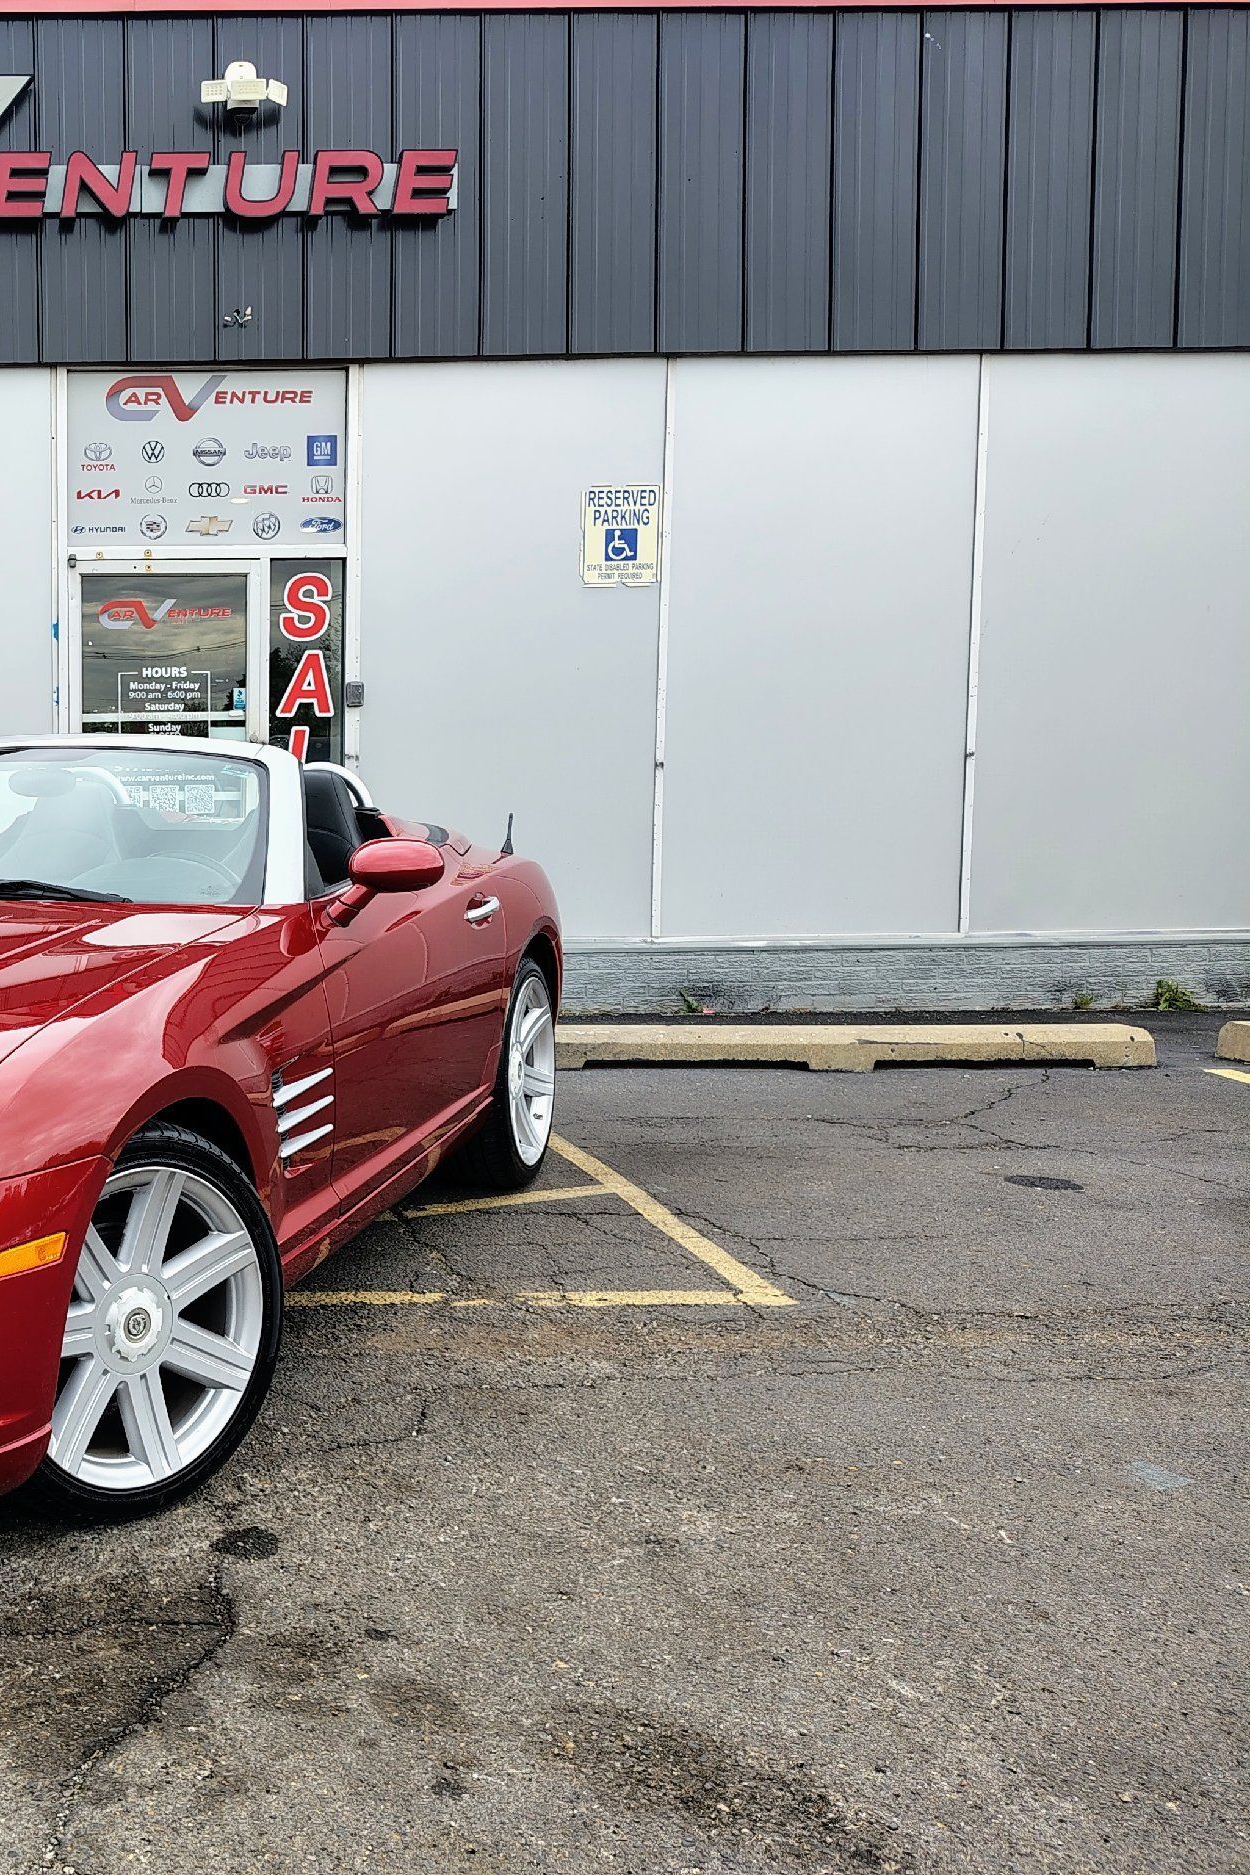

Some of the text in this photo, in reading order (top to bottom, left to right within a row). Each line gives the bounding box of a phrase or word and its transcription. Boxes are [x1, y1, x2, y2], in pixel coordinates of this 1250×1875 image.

[244, 443, 292, 461] Jeep
[313, 442, 331, 455] GM
[77, 489, 120, 499] KIA
[243, 485, 288, 495] GMC
[588, 489, 656, 507] RESERVED
[593, 508, 650, 526] PARKING
[311, 519, 334, 531] Ford
[605, 563, 629, 571] DISABLED
[631, 563, 654, 571] PARKING
[618, 572, 642, 580] REQUIRED
[142, 667, 188, 678] HOURS
[130, 681, 165, 691] Monday
[172, 681, 201, 691] Friday
[128, 691, 147, 699] 9:00
[167, 691, 185, 699] 6:00
[186, 692, 201, 700] pm
[144, 703, 185, 712] Saturday
[148, 723, 182, 733] Sunday
